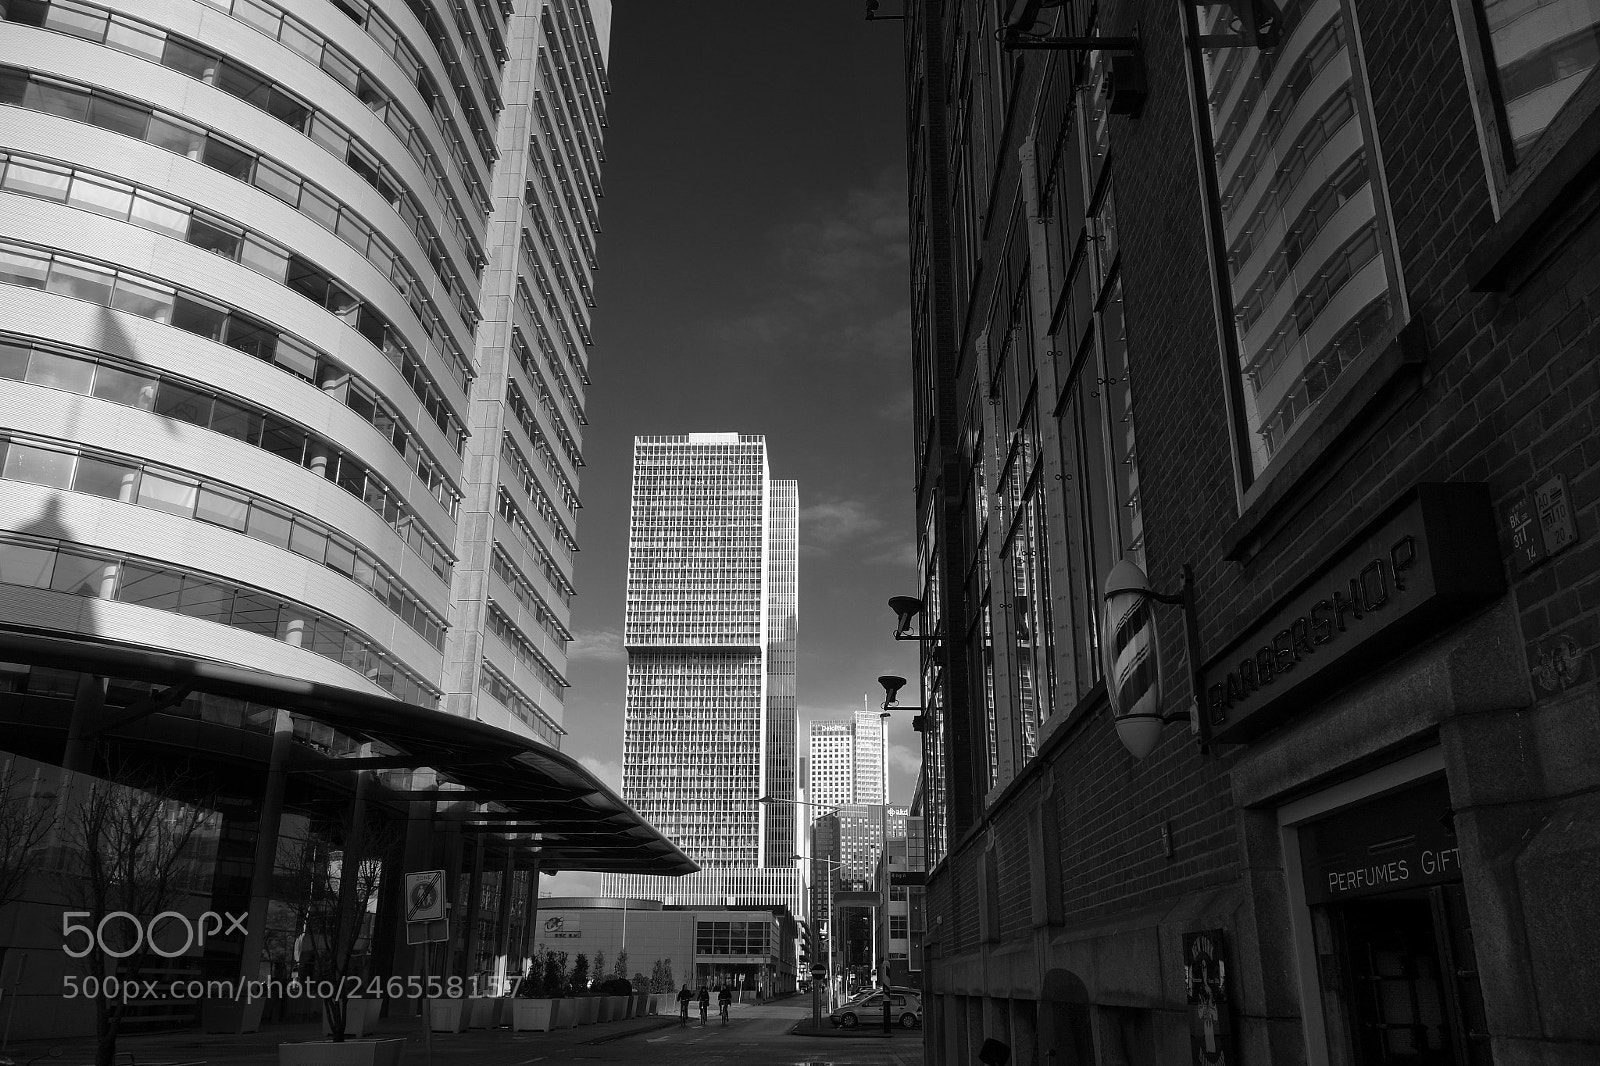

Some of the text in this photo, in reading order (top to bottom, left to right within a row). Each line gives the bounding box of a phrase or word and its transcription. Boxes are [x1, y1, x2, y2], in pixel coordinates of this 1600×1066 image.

[1205, 534, 1414, 726] BARBERSHOP
[416, 874, 432, 882] ZONE
[1328, 847, 1462, 893] PERFUMES GIFT
